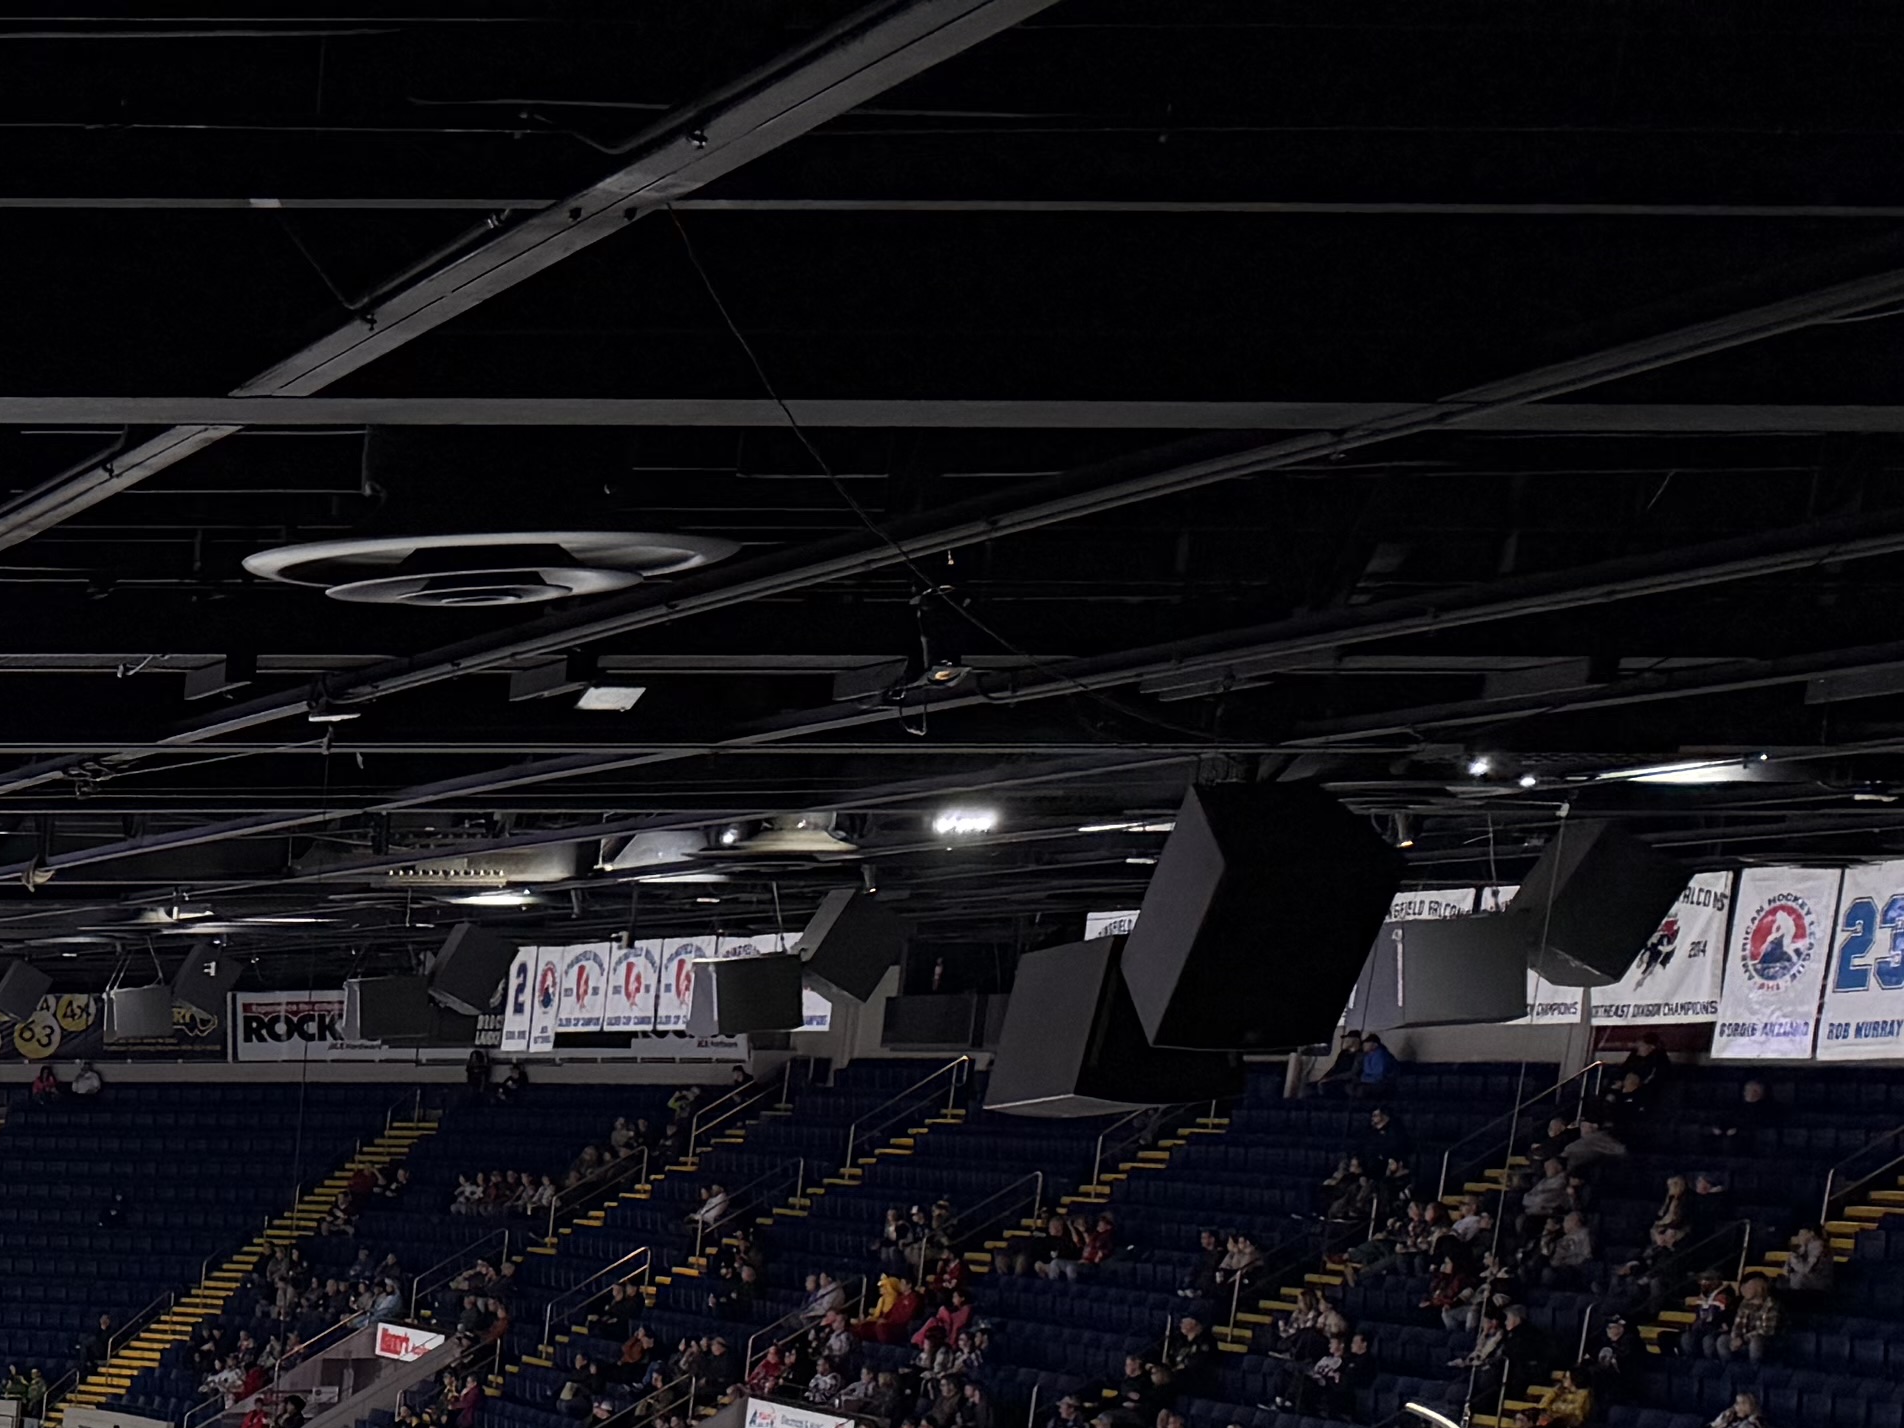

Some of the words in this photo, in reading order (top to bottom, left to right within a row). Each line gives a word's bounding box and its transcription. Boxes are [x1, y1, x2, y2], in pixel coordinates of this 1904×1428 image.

[1767, 892, 1812, 917] HOCKEY
[1687, 940, 1708, 959] 2014
[1832, 892, 1904, 994] 23
[512, 962, 528, 1015] 2
[1663, 1001, 1719, 1017] CHAMPIONS
[19, 1018, 55, 1048] 63
[1827, 1022, 1849, 1040] ROB
[1854, 1019, 1903, 1040] MURRAY
